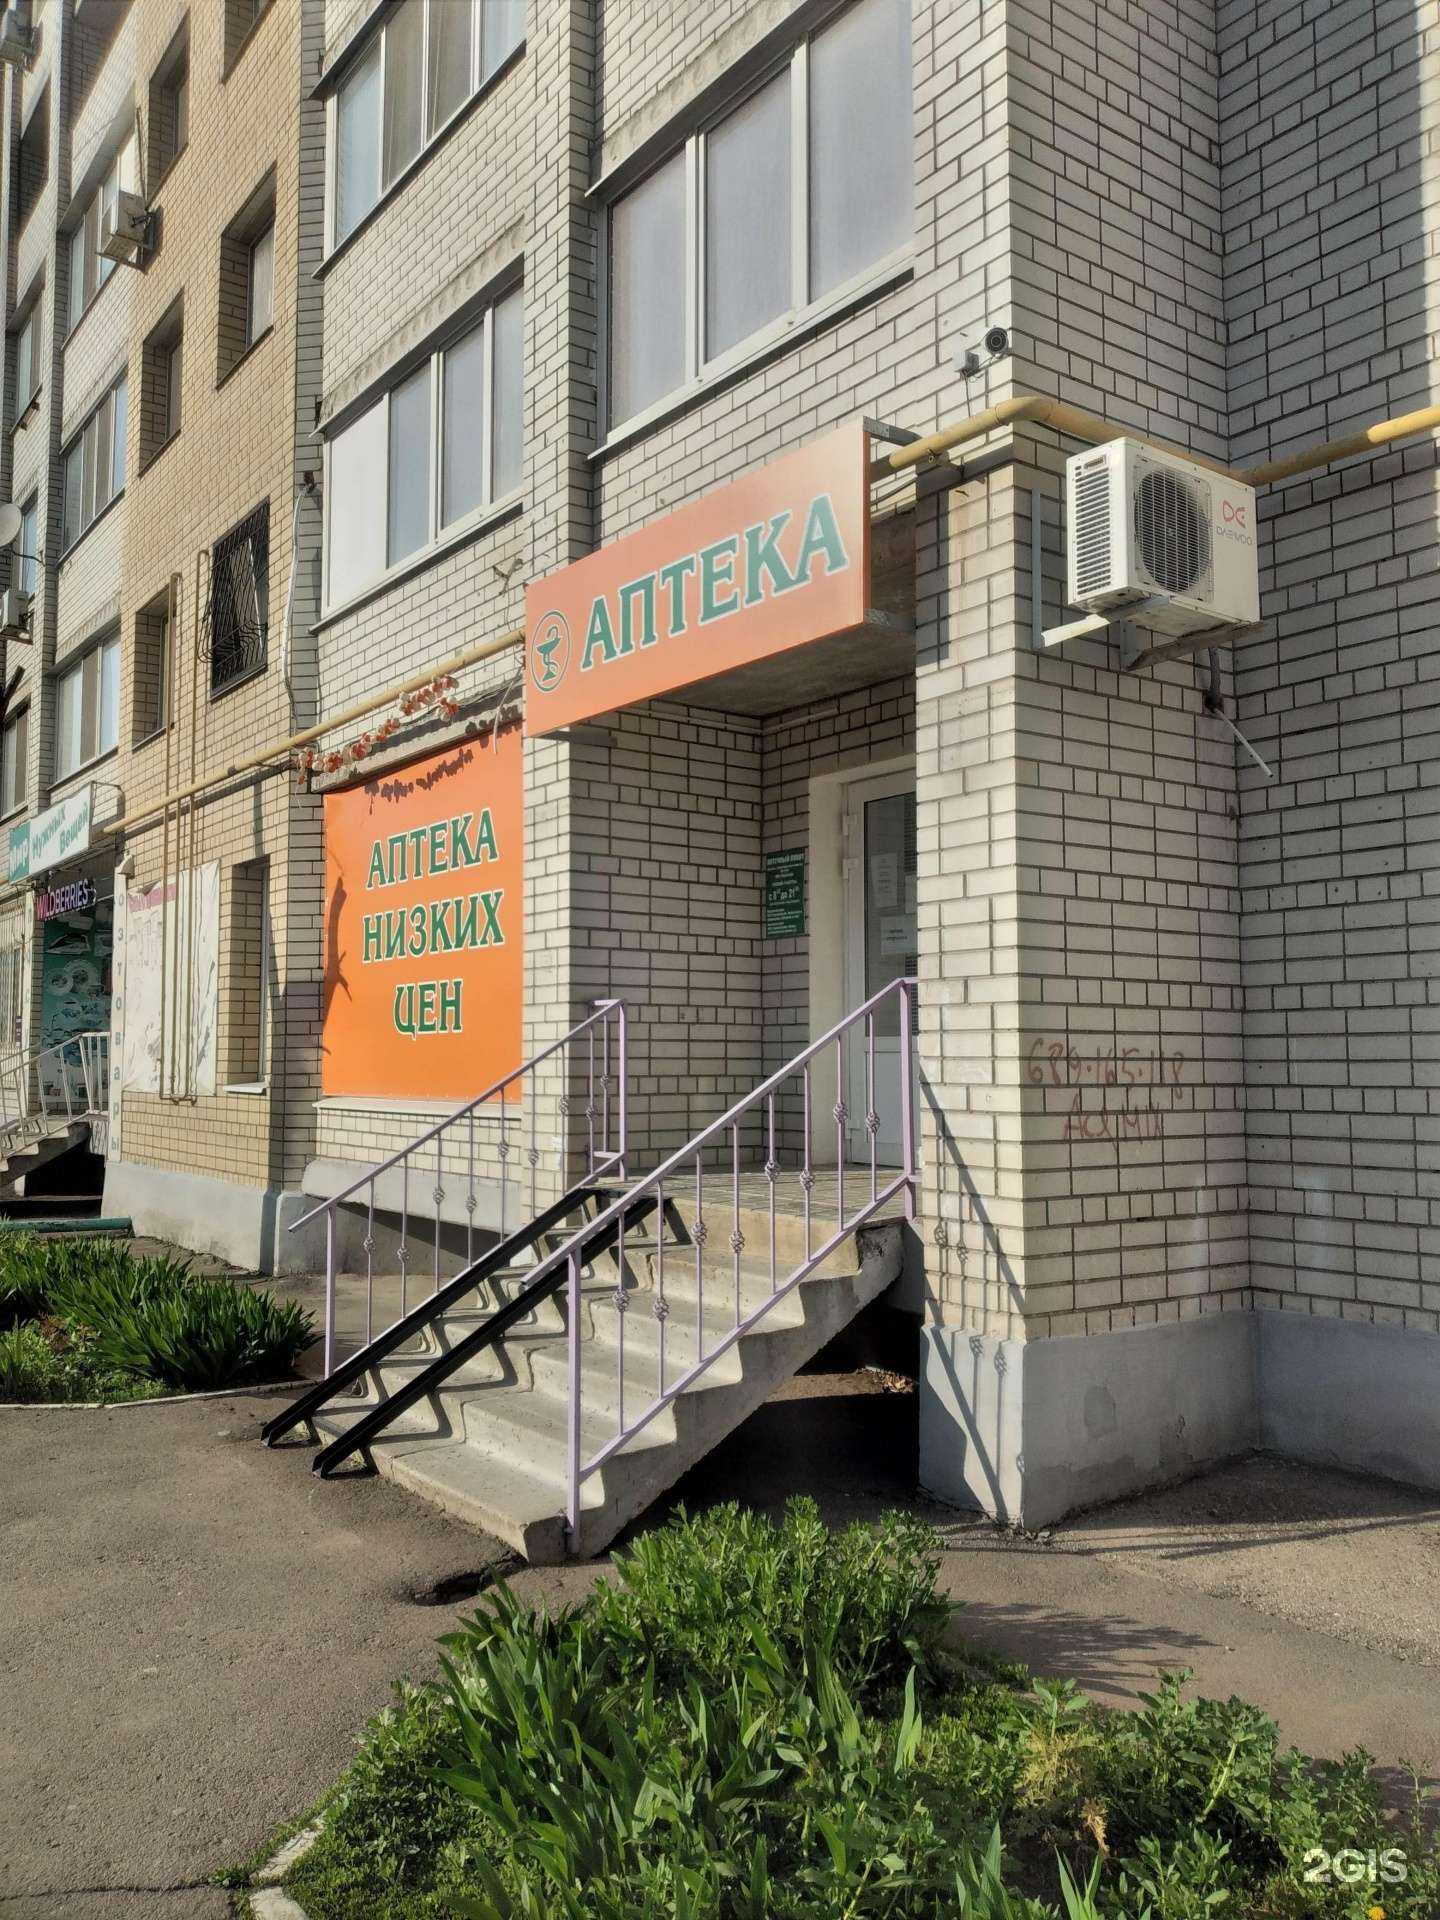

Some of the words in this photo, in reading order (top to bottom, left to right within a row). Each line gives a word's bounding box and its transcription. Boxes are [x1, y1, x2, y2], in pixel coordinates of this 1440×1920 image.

[581, 493, 849, 671] АПТЕКА
[366, 807, 499, 890] АПТЕКА
[36, 879, 89, 920] WILDBERRIES
[362, 889, 505, 963] НИЗКИХ
[393, 978, 464, 1040] ЦЕН
